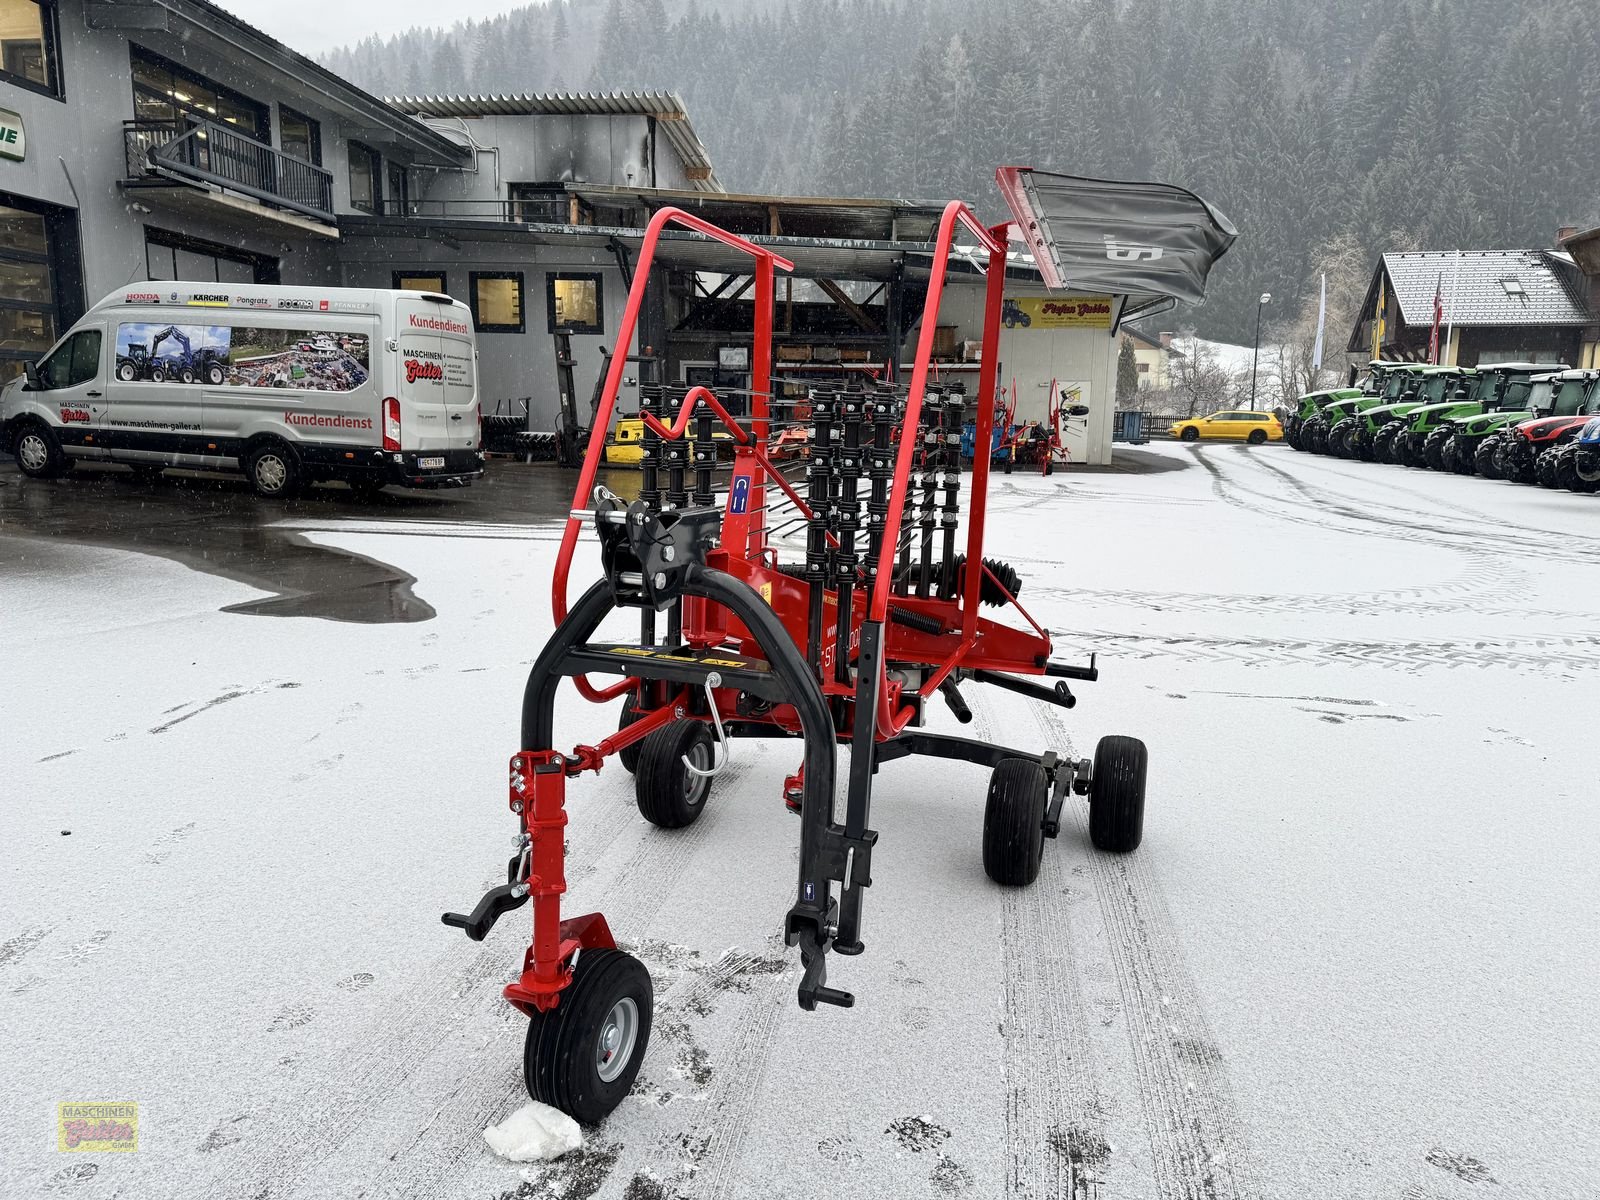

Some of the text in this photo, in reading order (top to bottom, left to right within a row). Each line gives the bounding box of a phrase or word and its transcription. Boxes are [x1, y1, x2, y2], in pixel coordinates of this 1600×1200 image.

[236, 296, 268, 306] Pongratz
[409, 313, 468, 335] Kundendienst
[403, 349, 442, 360] MASCHINEN
[404, 359, 443, 384] Gailer
[61, 408, 90, 424] Gailer
[284, 412, 373, 429] Kundendienst
[110, 419, 202, 432] www.maschinen-gailer.at
